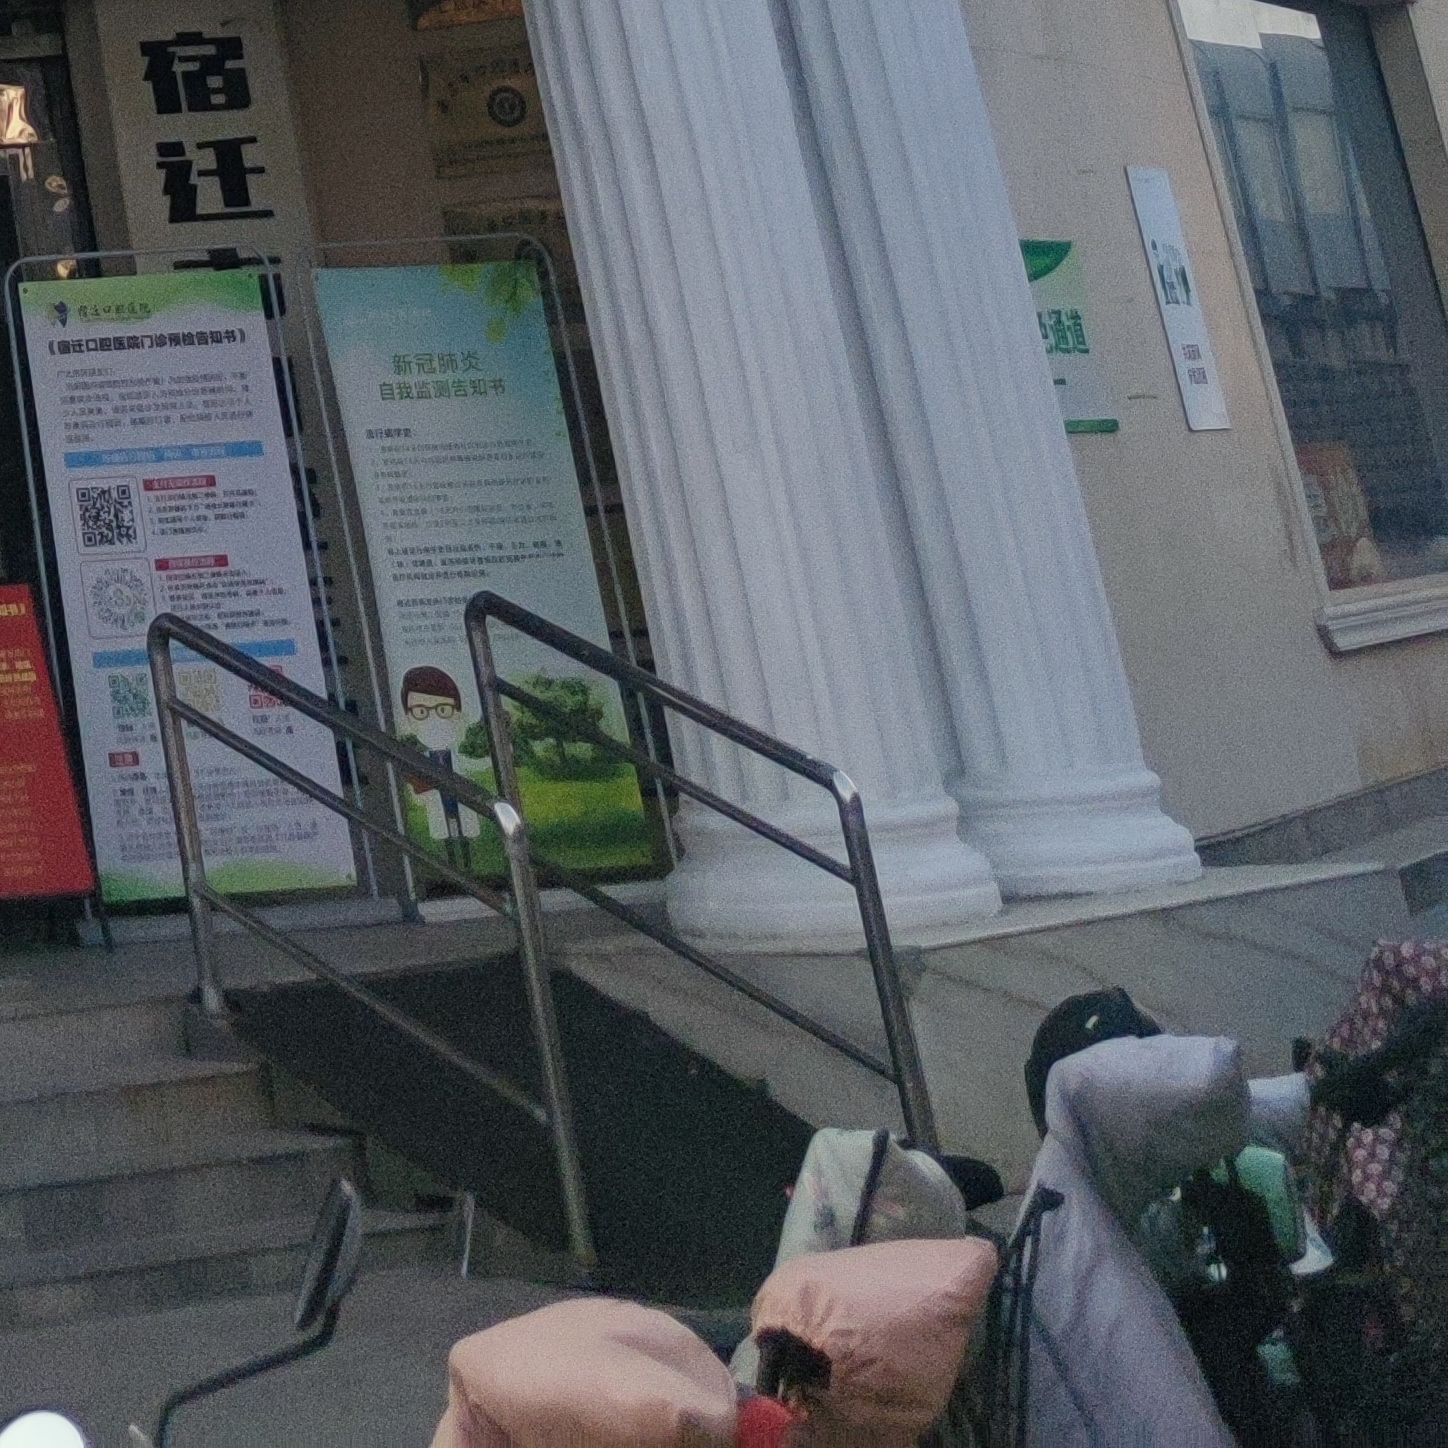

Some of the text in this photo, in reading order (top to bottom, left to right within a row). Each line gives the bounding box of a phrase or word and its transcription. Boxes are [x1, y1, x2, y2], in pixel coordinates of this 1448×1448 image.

[392, 351, 482, 375] 新冠肺炎
[379, 378, 506, 401] 自我监测告知书
